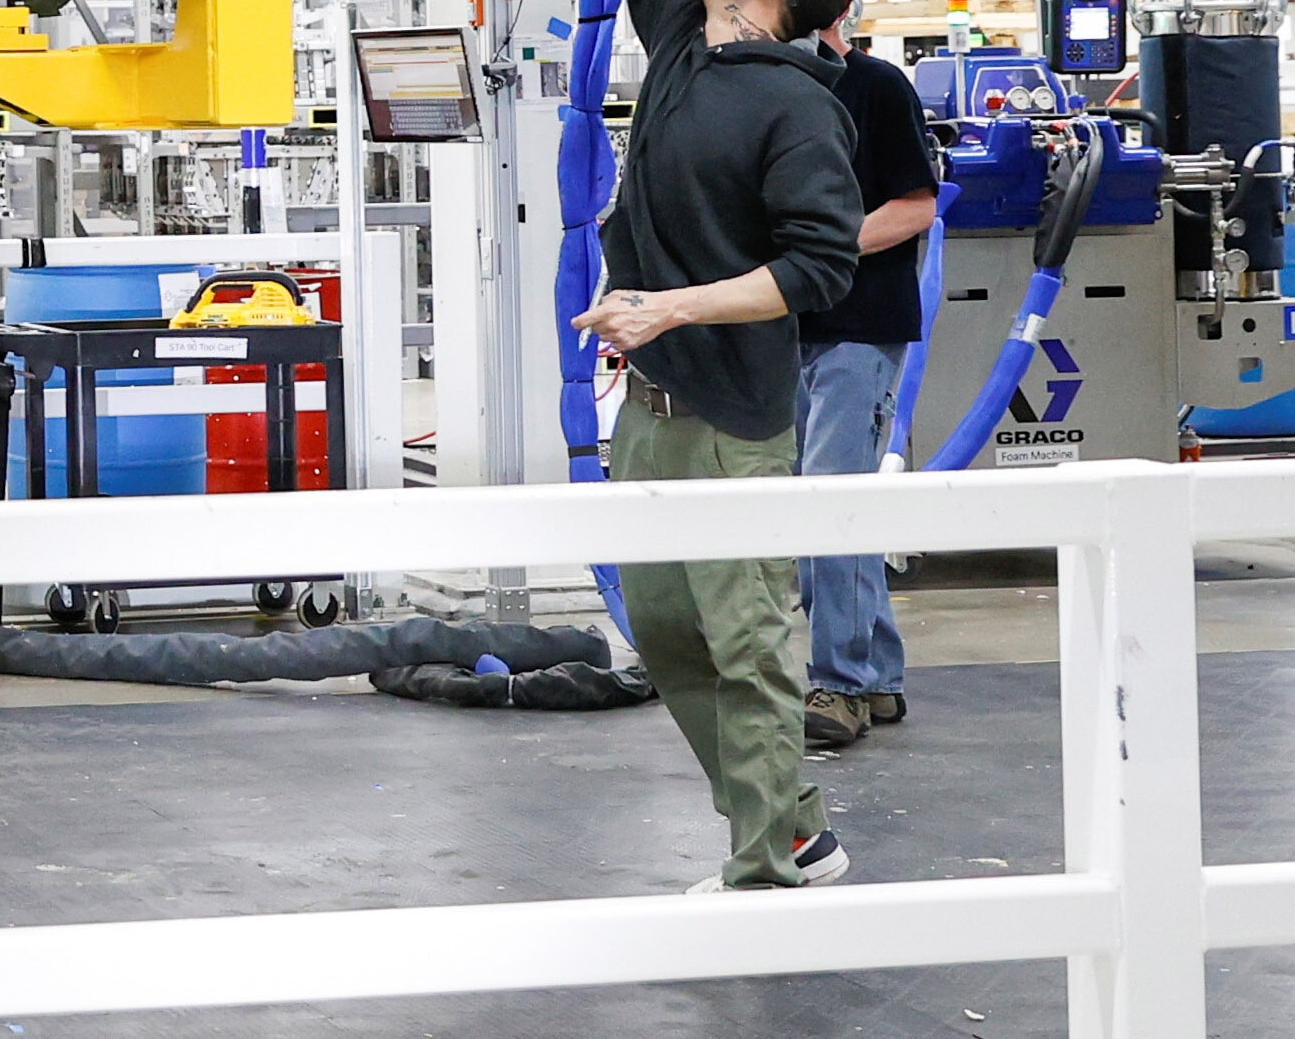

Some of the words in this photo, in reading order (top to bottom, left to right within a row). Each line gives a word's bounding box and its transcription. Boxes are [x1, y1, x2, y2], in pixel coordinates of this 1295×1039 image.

[169, 343, 185, 351] STA
[199, 343, 215, 351] Tool
[996, 429, 1084, 445] GRACO
[1001, 451, 1028, 462] Foam
[1031, 449, 1073, 460] Machine
